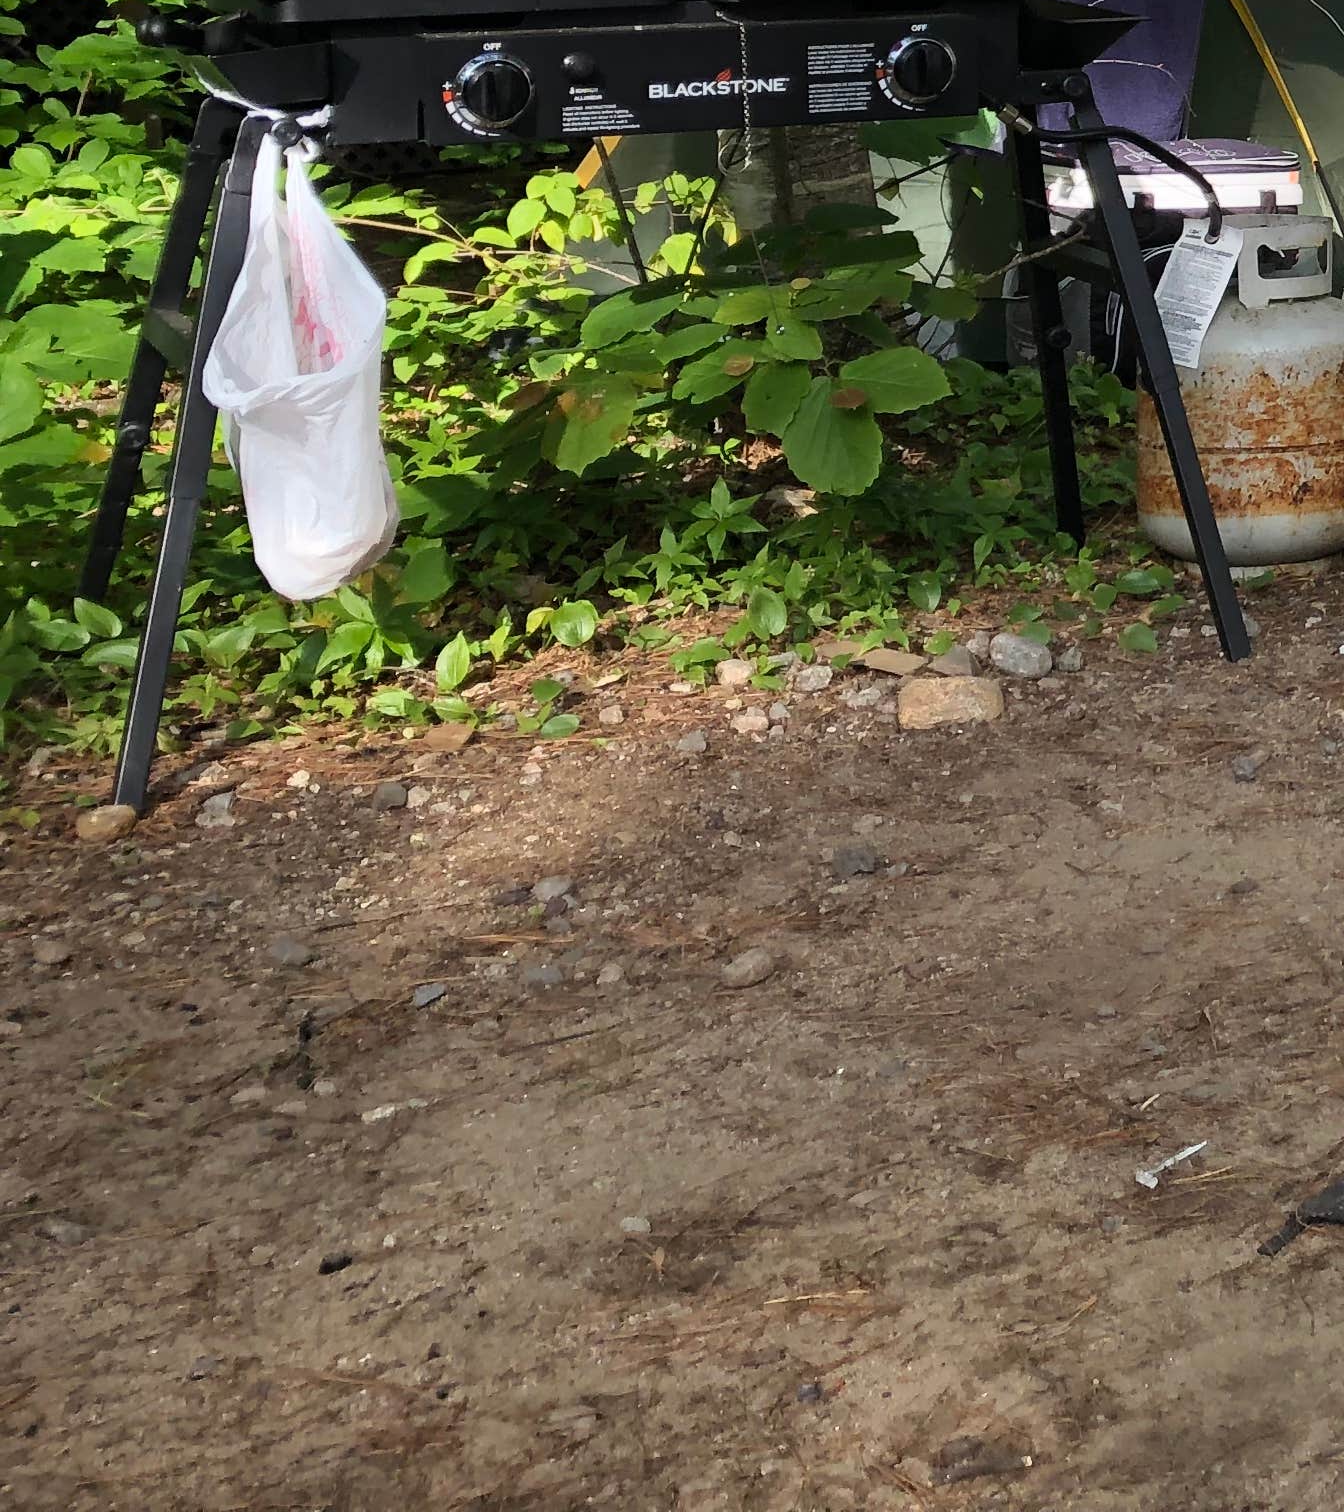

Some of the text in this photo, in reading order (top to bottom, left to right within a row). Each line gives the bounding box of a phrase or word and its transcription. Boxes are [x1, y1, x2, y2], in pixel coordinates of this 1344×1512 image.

[911, 23, 929, 32] OFF
[483, 42, 503, 51] OFF
[648, 77, 788, 99] BLACKSTONE
